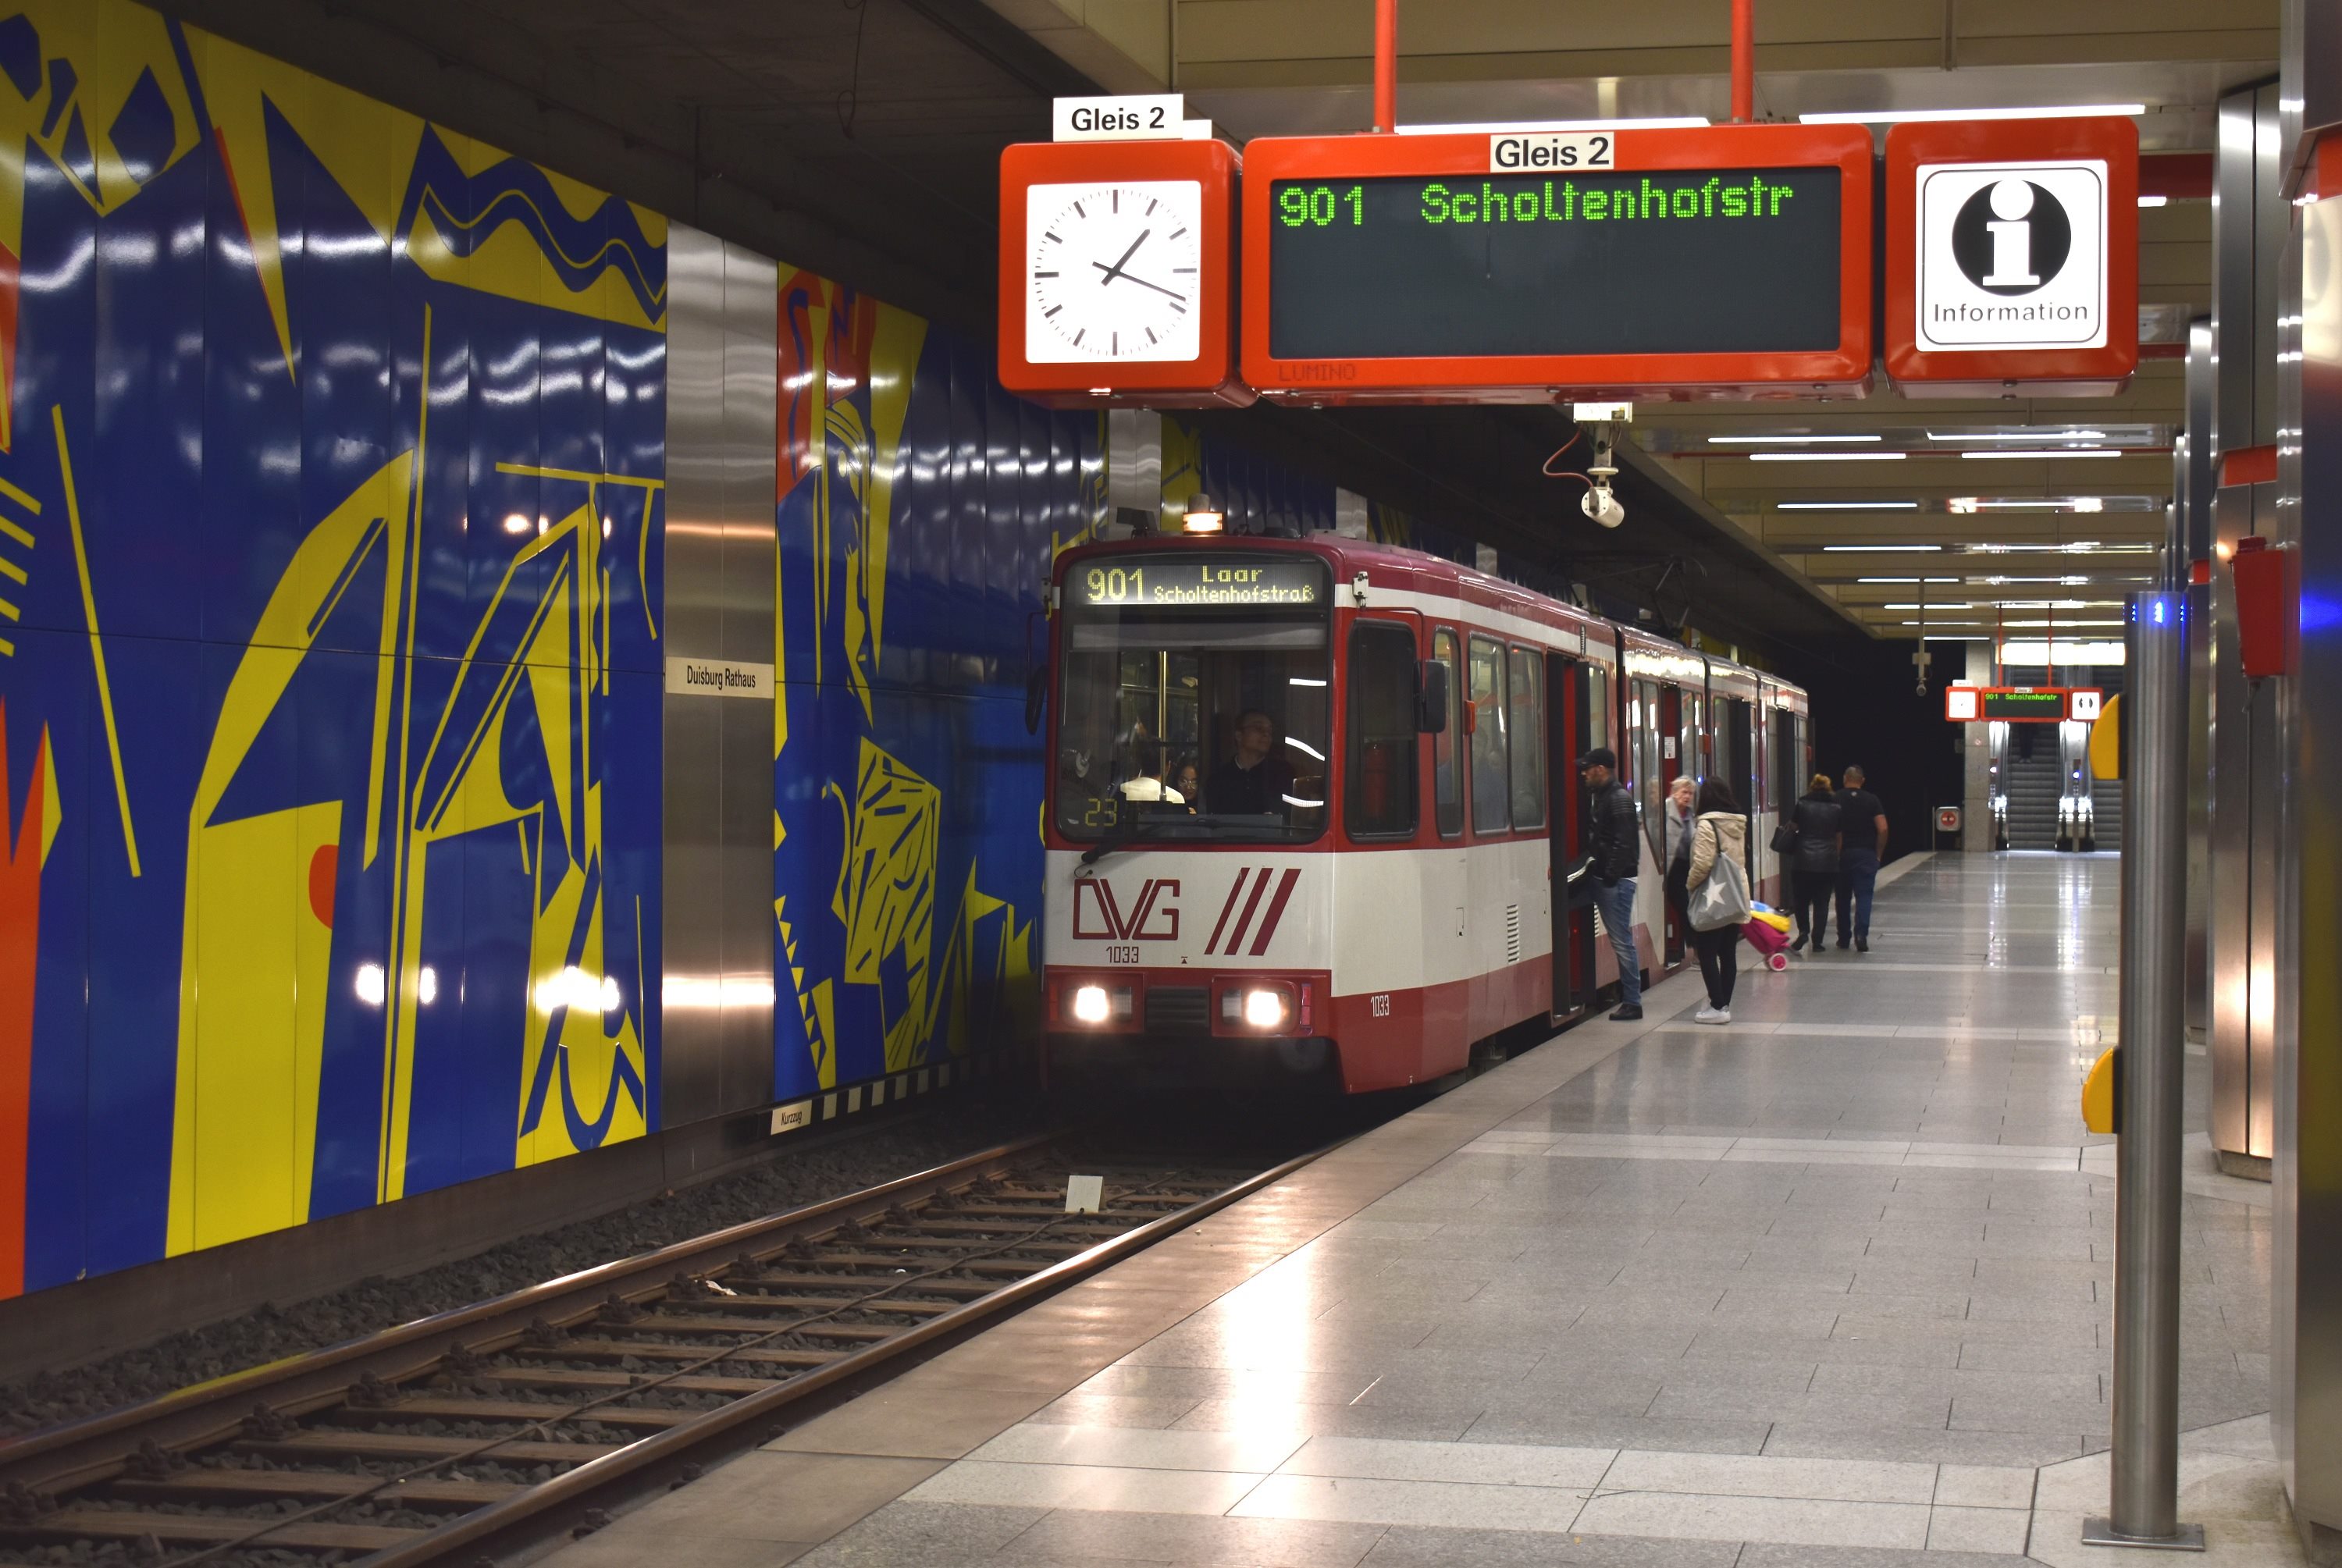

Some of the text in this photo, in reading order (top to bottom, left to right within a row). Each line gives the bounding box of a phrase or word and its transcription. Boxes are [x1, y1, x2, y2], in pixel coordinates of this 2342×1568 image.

[1071, 107, 1165, 130] Gleis 2
[1494, 137, 1610, 169] Gleis 2
[1280, 176, 1793, 226] 901 Scholtenhofstr
[1934, 301, 2088, 322] Information
[1280, 364, 1355, 382] LUMINO
[1087, 568, 1144, 602] 901
[1202, 566, 1262, 583] Laar
[1154, 585, 1314, 603] Scholtenhofstraß
[687, 665, 756, 690] Duisburg Rathaus
[1085, 798, 1117, 827] 23
[1105, 946, 1139, 963] 1033
[1370, 994, 1390, 1017] 1033
[781, 1111, 803, 1126] Kurzzug
